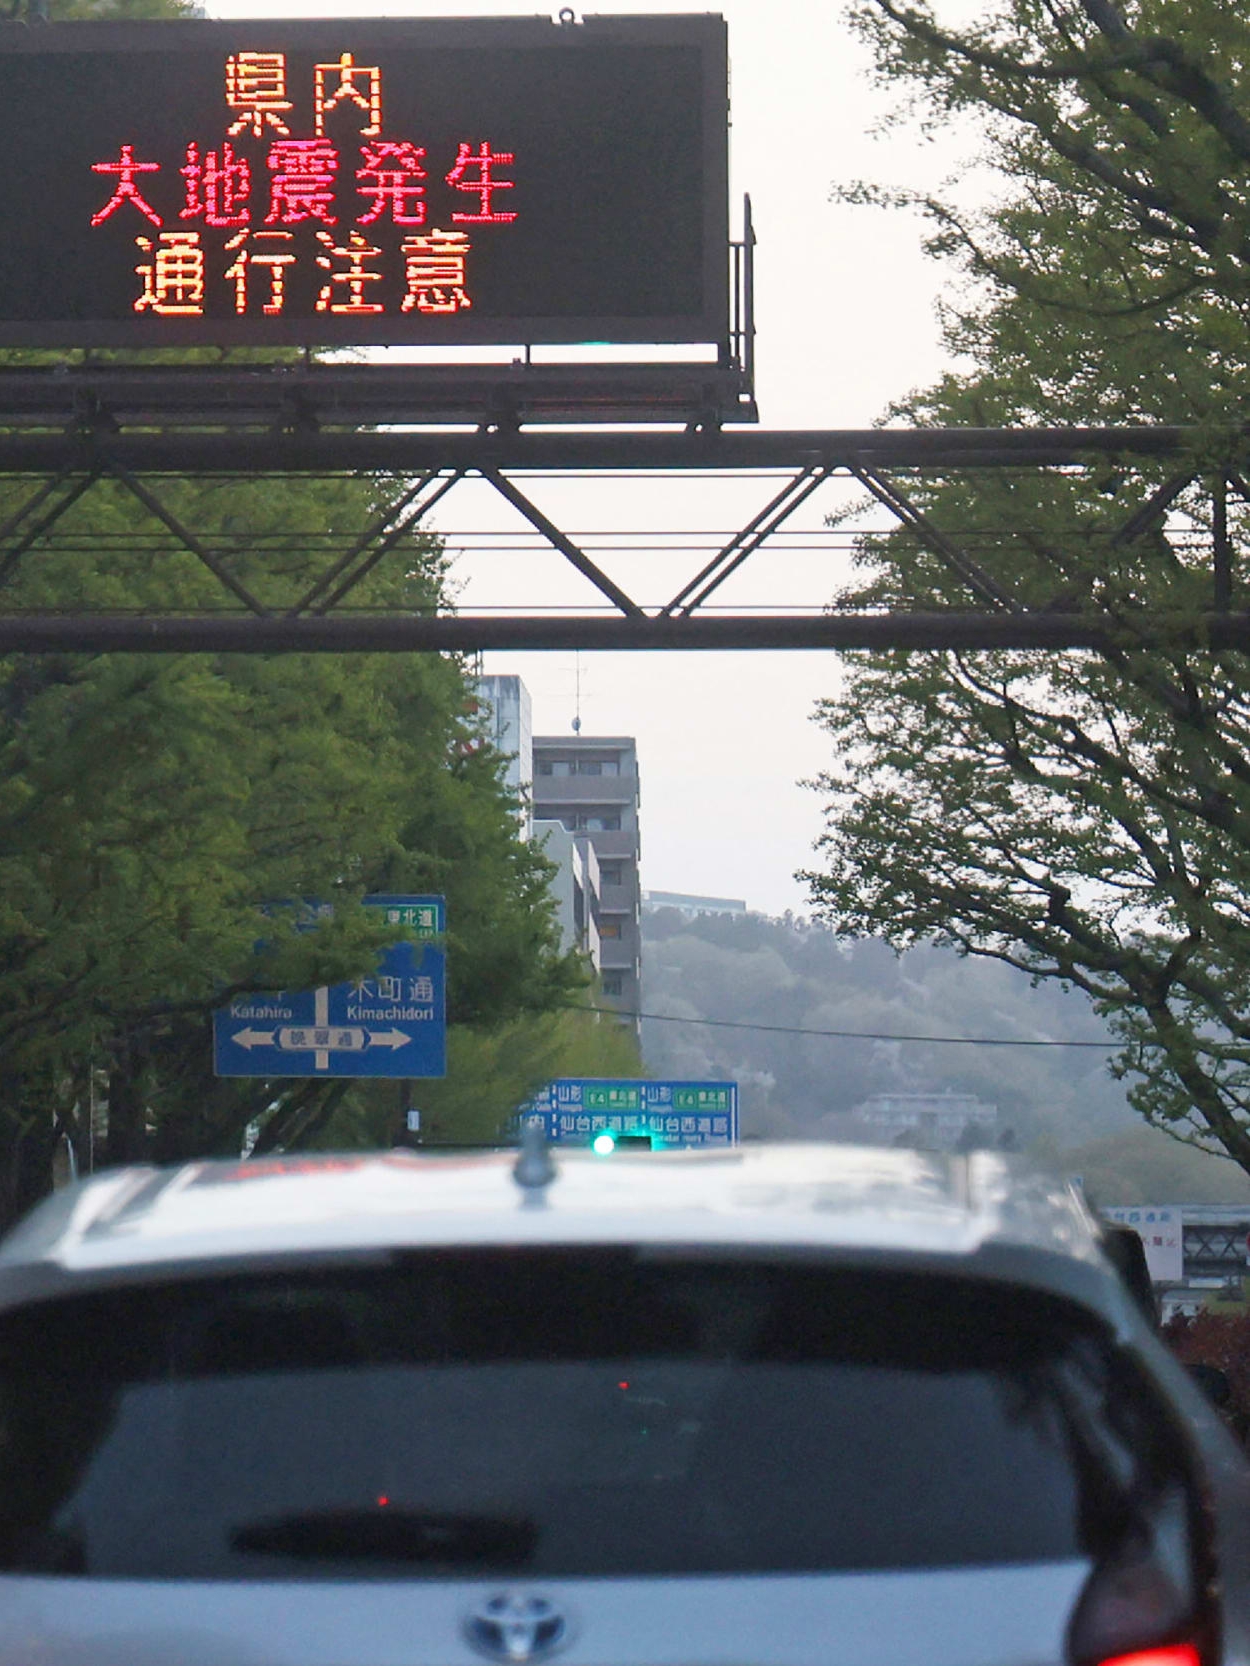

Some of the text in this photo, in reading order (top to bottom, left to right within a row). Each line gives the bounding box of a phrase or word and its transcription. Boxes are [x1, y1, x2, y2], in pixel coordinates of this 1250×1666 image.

[225, 51, 383, 136] 県内
[91, 139, 519, 226] 大地震発生
[134, 228, 473, 314] 通行注意
[347, 976, 434, 1002] 木町通
[231, 1005, 293, 1020] Katahira
[347, 1006, 434, 1021] Kimachidori
[558, 1085, 583, 1101] 山形
